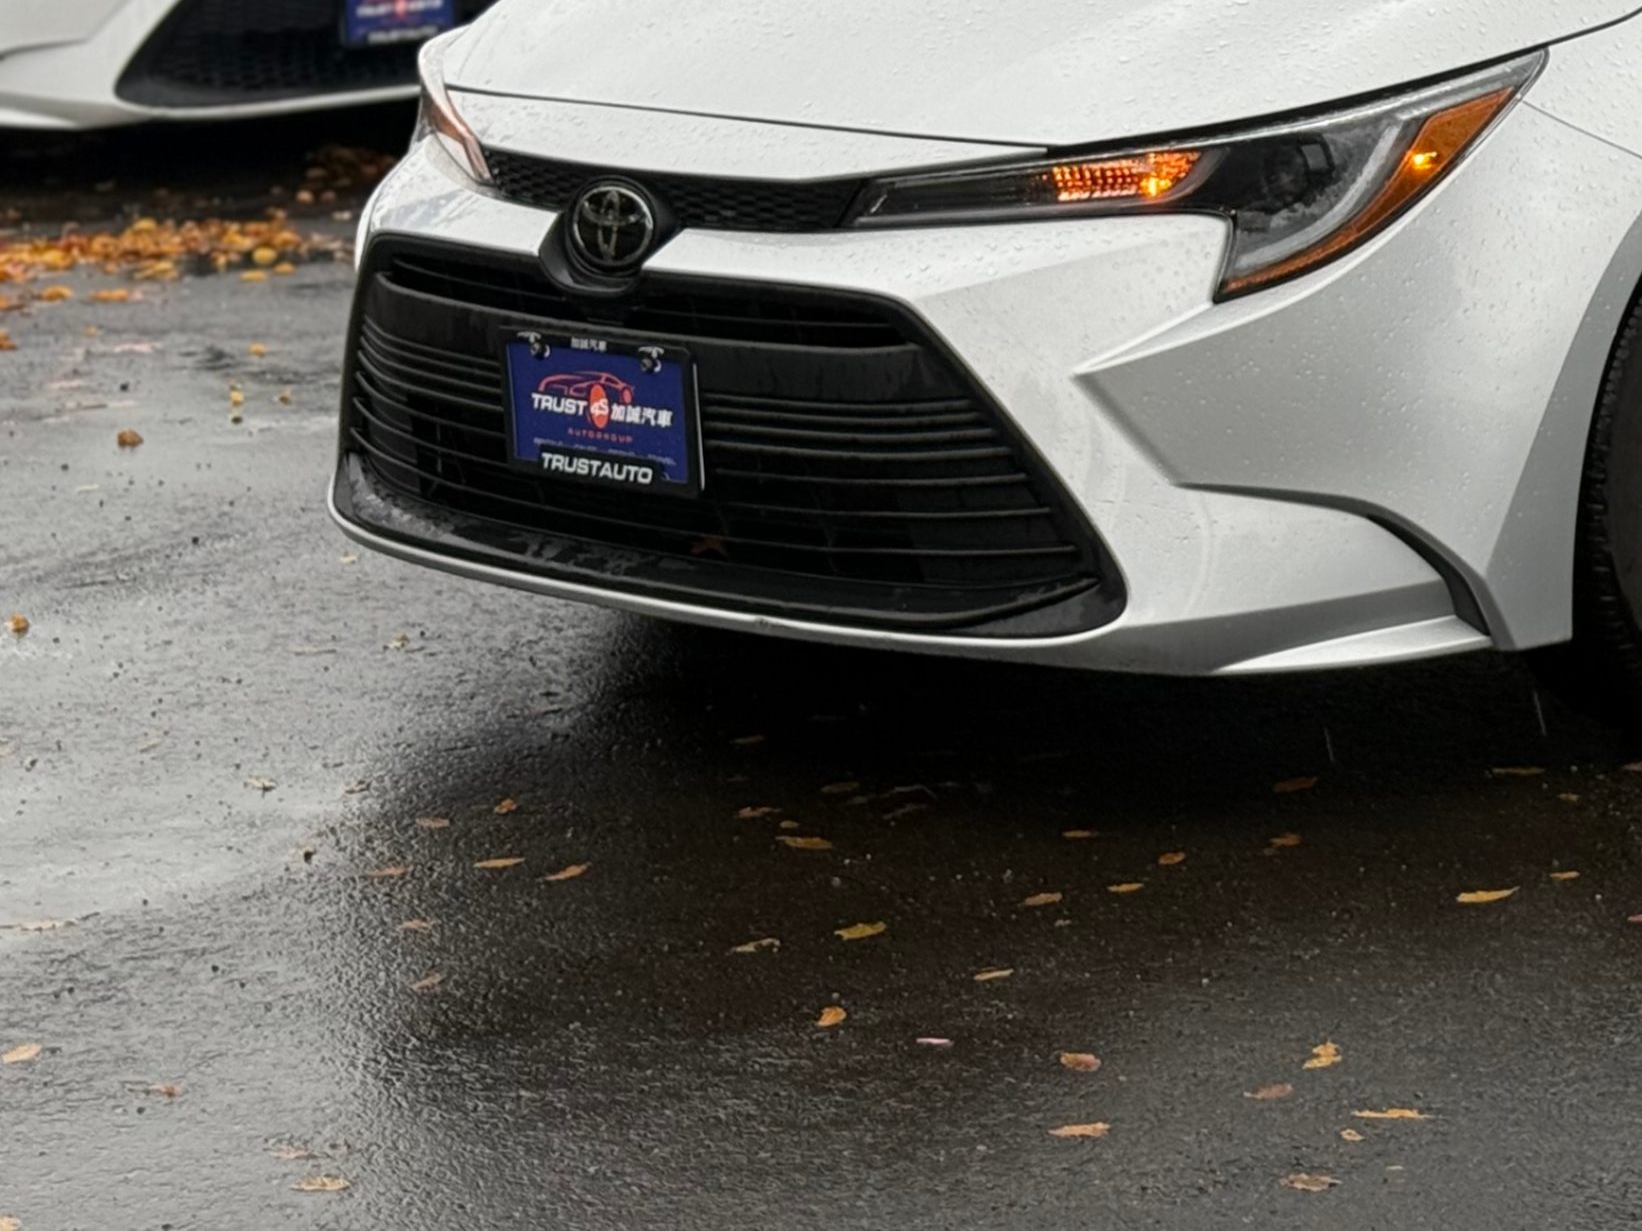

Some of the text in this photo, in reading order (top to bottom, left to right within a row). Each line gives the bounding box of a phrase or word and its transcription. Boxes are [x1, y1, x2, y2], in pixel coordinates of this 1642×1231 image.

[531, 392, 588, 416] TRUST
[610, 402, 673, 428] 加誠汽車
[541, 452, 653, 484] TRUSTAUTO
